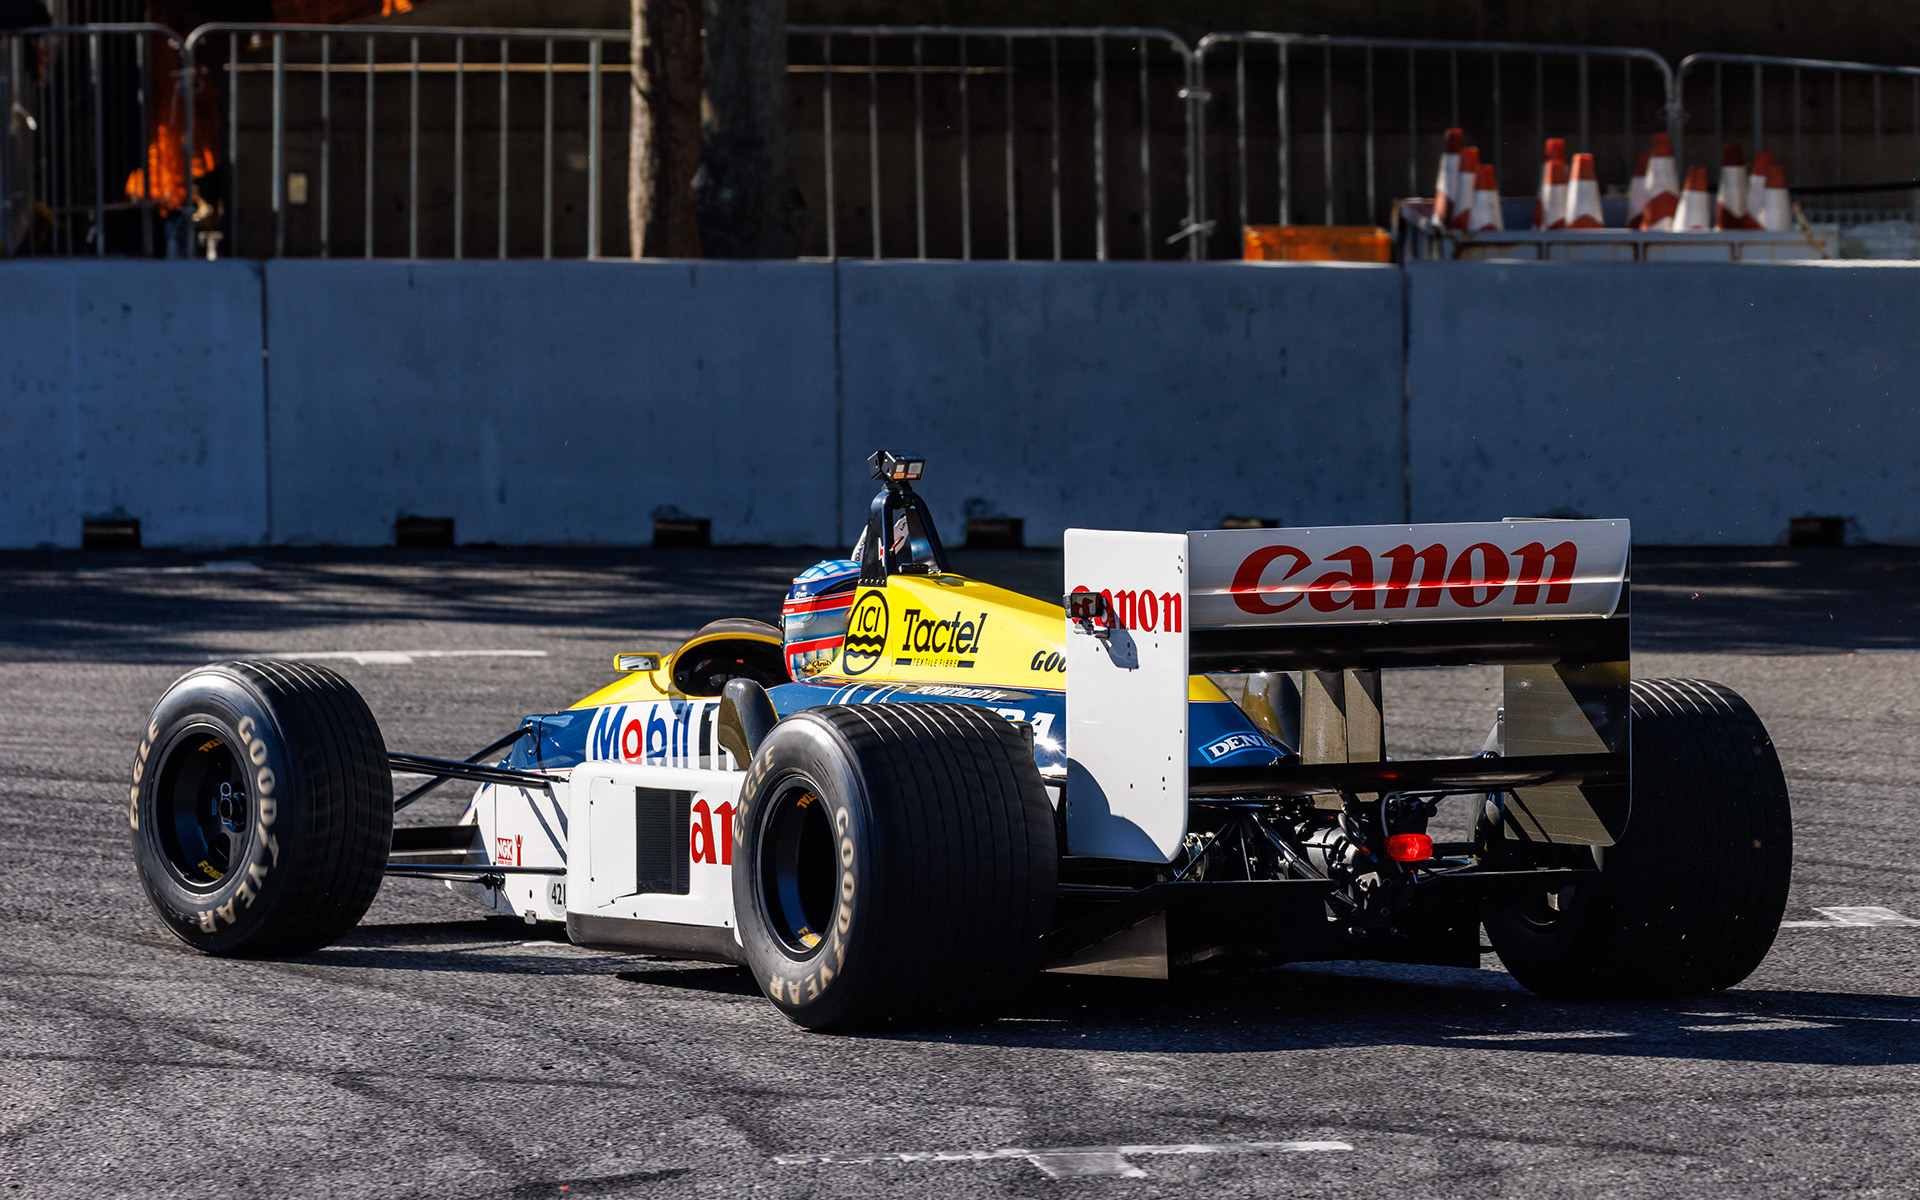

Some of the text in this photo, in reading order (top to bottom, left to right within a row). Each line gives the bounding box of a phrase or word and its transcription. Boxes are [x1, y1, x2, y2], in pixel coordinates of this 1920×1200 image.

[1230, 540, 1578, 615] Canon
[857, 606, 881, 632] ICI
[902, 609, 988, 654] Tactel
[909, 686, 992, 699] POWERED
[592, 702, 694, 762] Mobil
[497, 838, 513, 860] NGK
